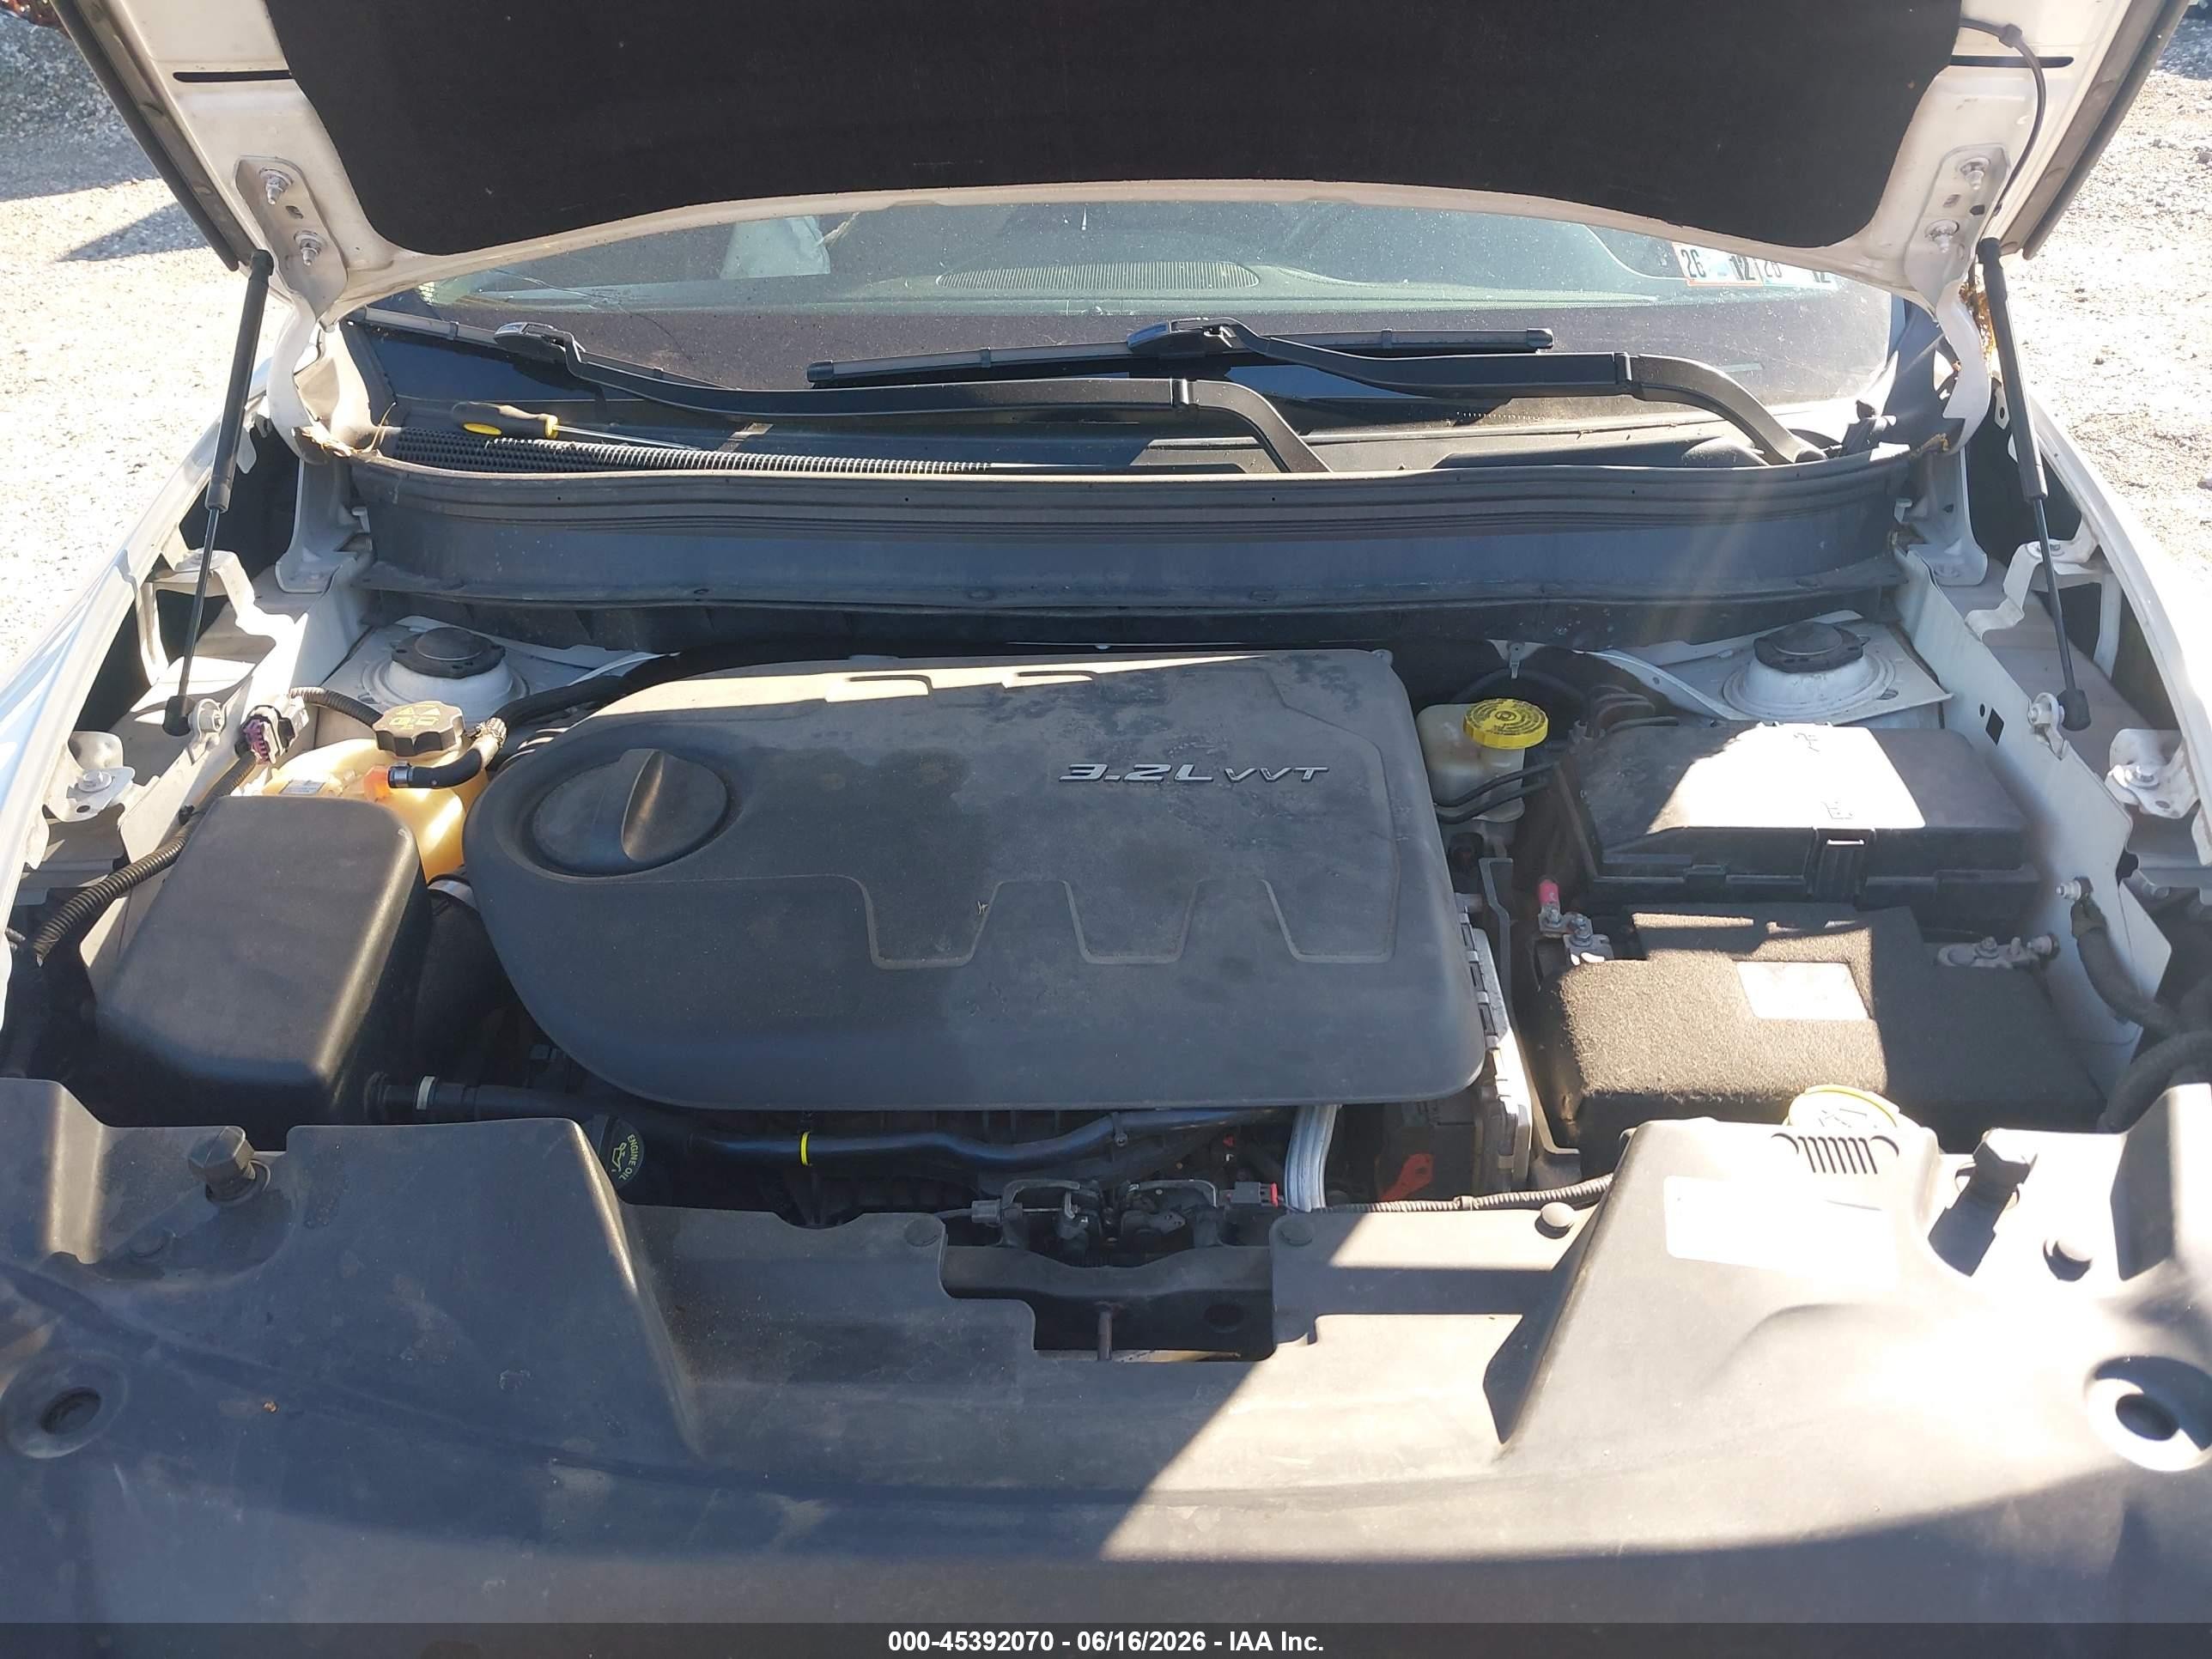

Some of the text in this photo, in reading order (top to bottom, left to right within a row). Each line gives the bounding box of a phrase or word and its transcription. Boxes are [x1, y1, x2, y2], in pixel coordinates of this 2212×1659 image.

[1680, 248, 1755, 281] 26 12
[1059, 763, 1329, 782] 3.2L VVT
[618, 1133, 639, 1181] ENGINE OIL
